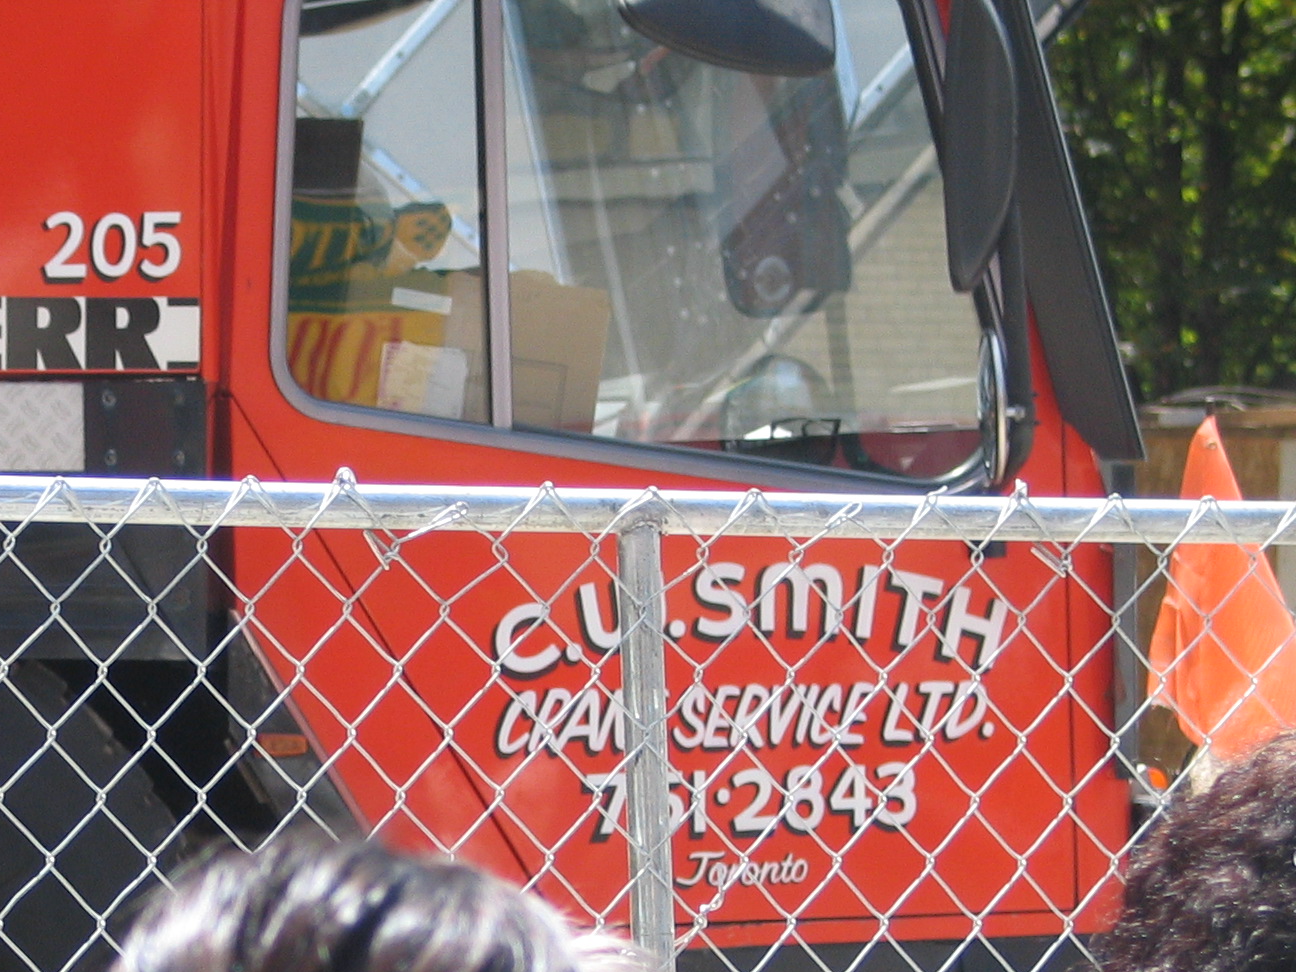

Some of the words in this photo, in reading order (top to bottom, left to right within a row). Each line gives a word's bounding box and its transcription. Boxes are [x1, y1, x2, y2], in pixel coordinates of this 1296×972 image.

[40, 211, 183, 281] 205
[497, 687, 671, 755] CRAN
[671, 682, 866, 751] SERVICE
[881, 680, 995, 742] LTD.
[675, 850, 810, 889] Toronto
